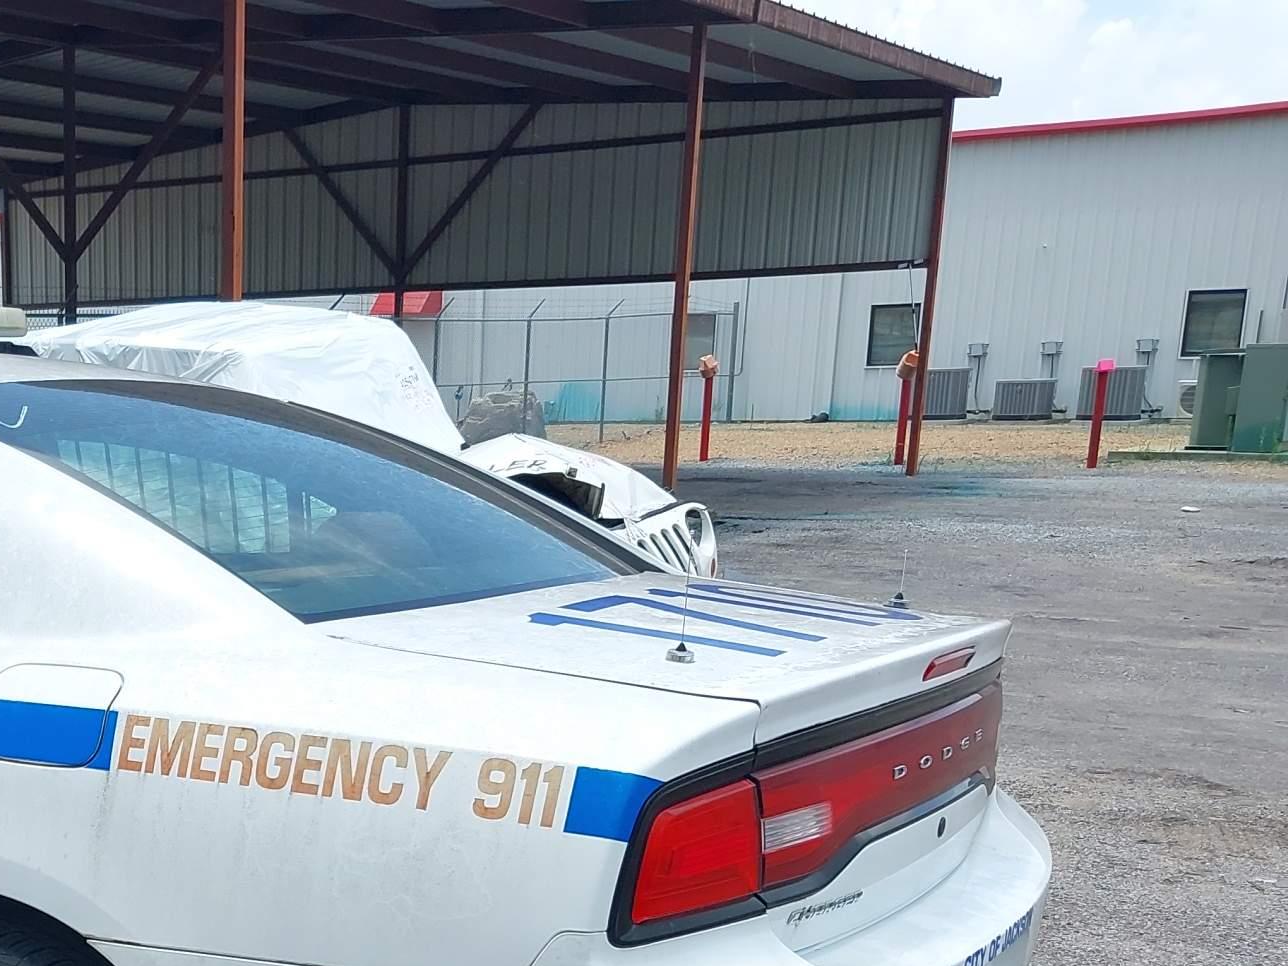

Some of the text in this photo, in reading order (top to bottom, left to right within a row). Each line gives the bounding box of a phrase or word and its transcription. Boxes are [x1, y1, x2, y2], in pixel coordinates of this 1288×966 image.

[116, 714, 565, 828] EMERGENCY 911
[893, 728, 984, 780] DODGE
[988, 934, 1002, 962] OF
